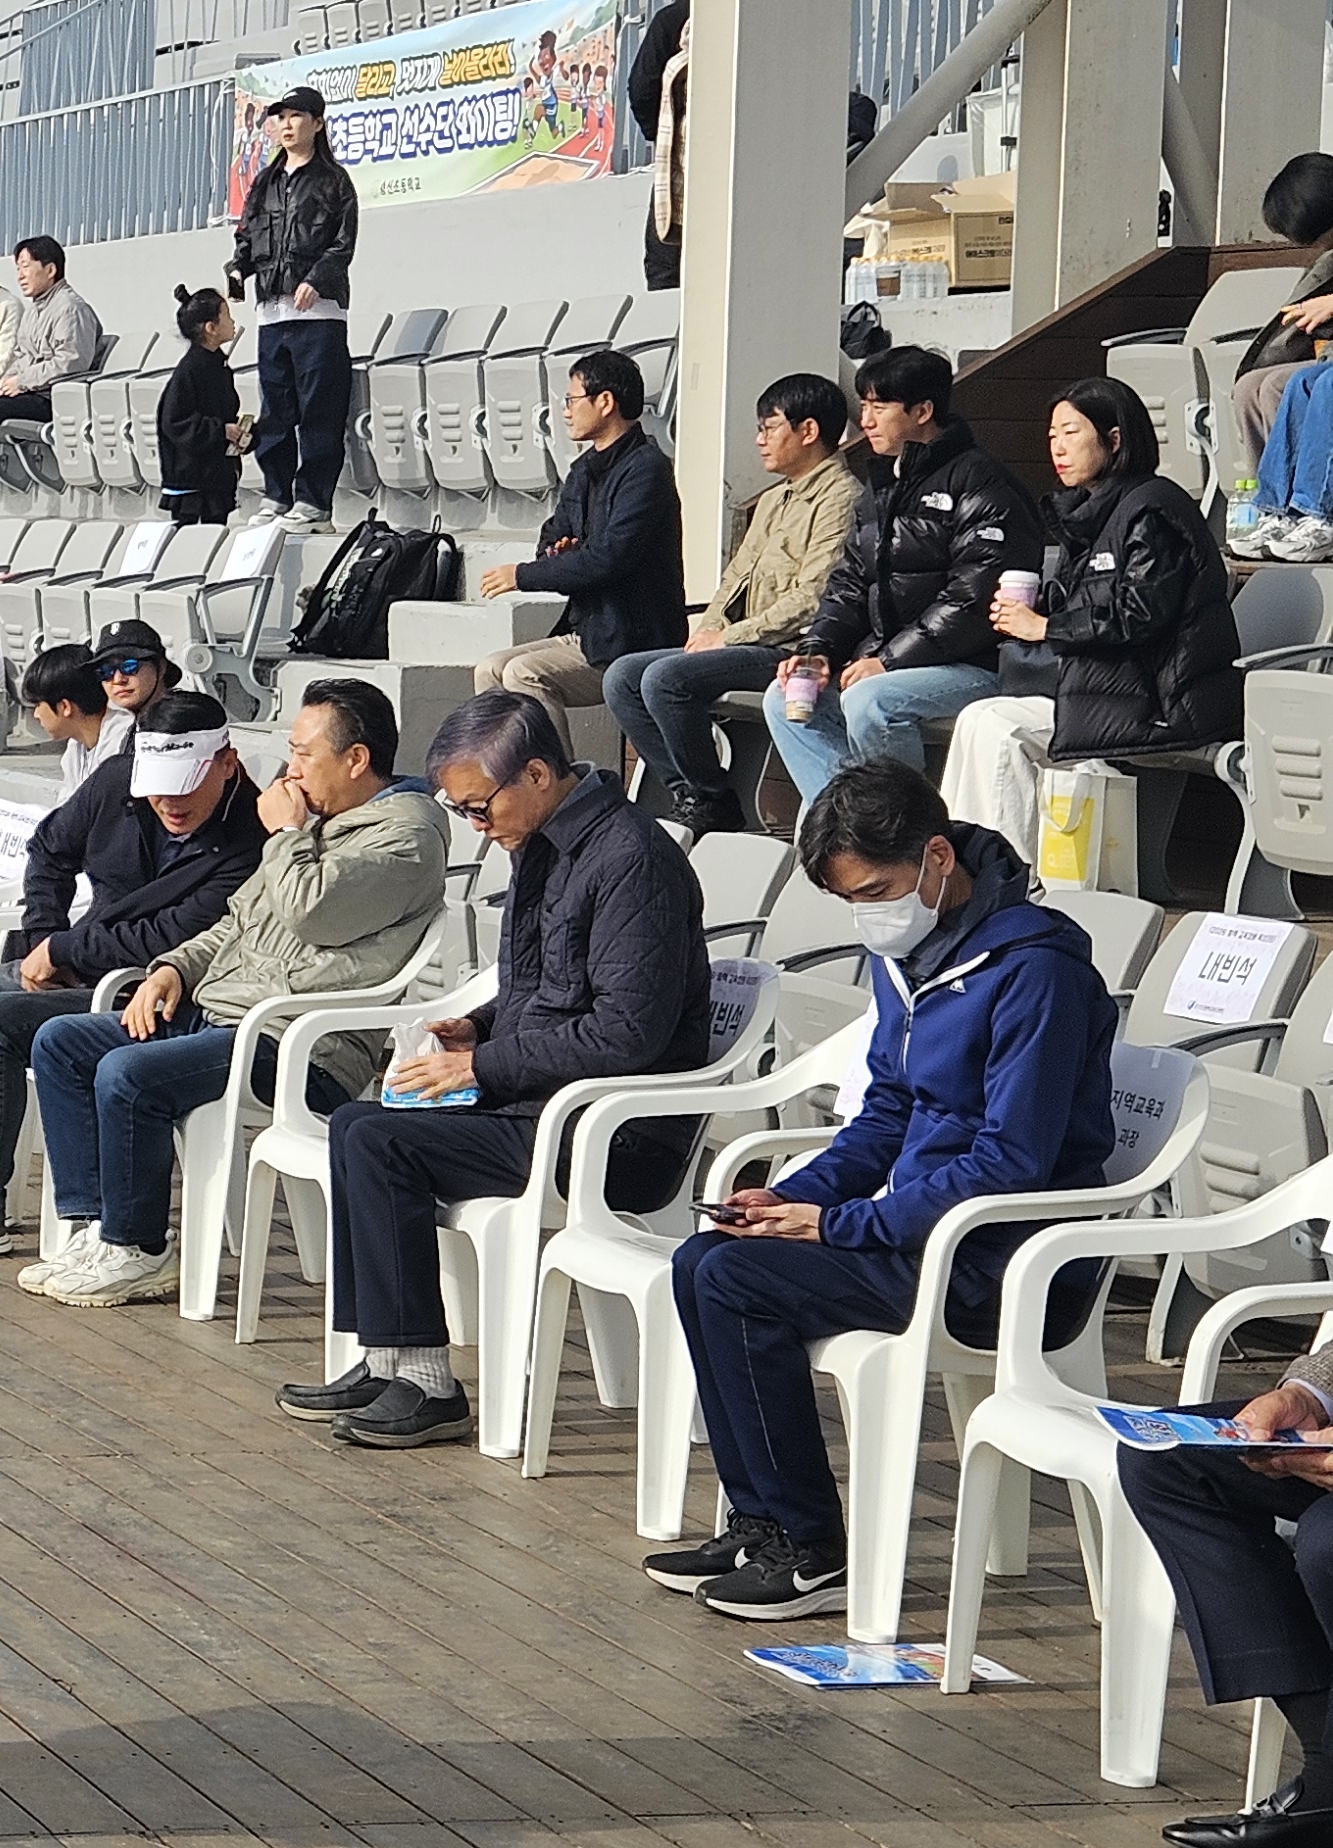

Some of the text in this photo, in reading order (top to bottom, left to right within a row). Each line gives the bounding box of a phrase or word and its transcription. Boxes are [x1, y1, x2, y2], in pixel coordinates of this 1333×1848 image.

[355, 60, 396, 100] 달리고,
[397, 52, 442, 96] 멋지게
[439, 38, 516, 87] 날아올라라!
[327, 88, 523, 165] 초등학교 선수단 화이팅!
[1197, 951, 1257, 986] 내빈석
[1112, 1090, 1165, 1120] 지역교육과
[1117, 1128, 1139, 1148] 과장
